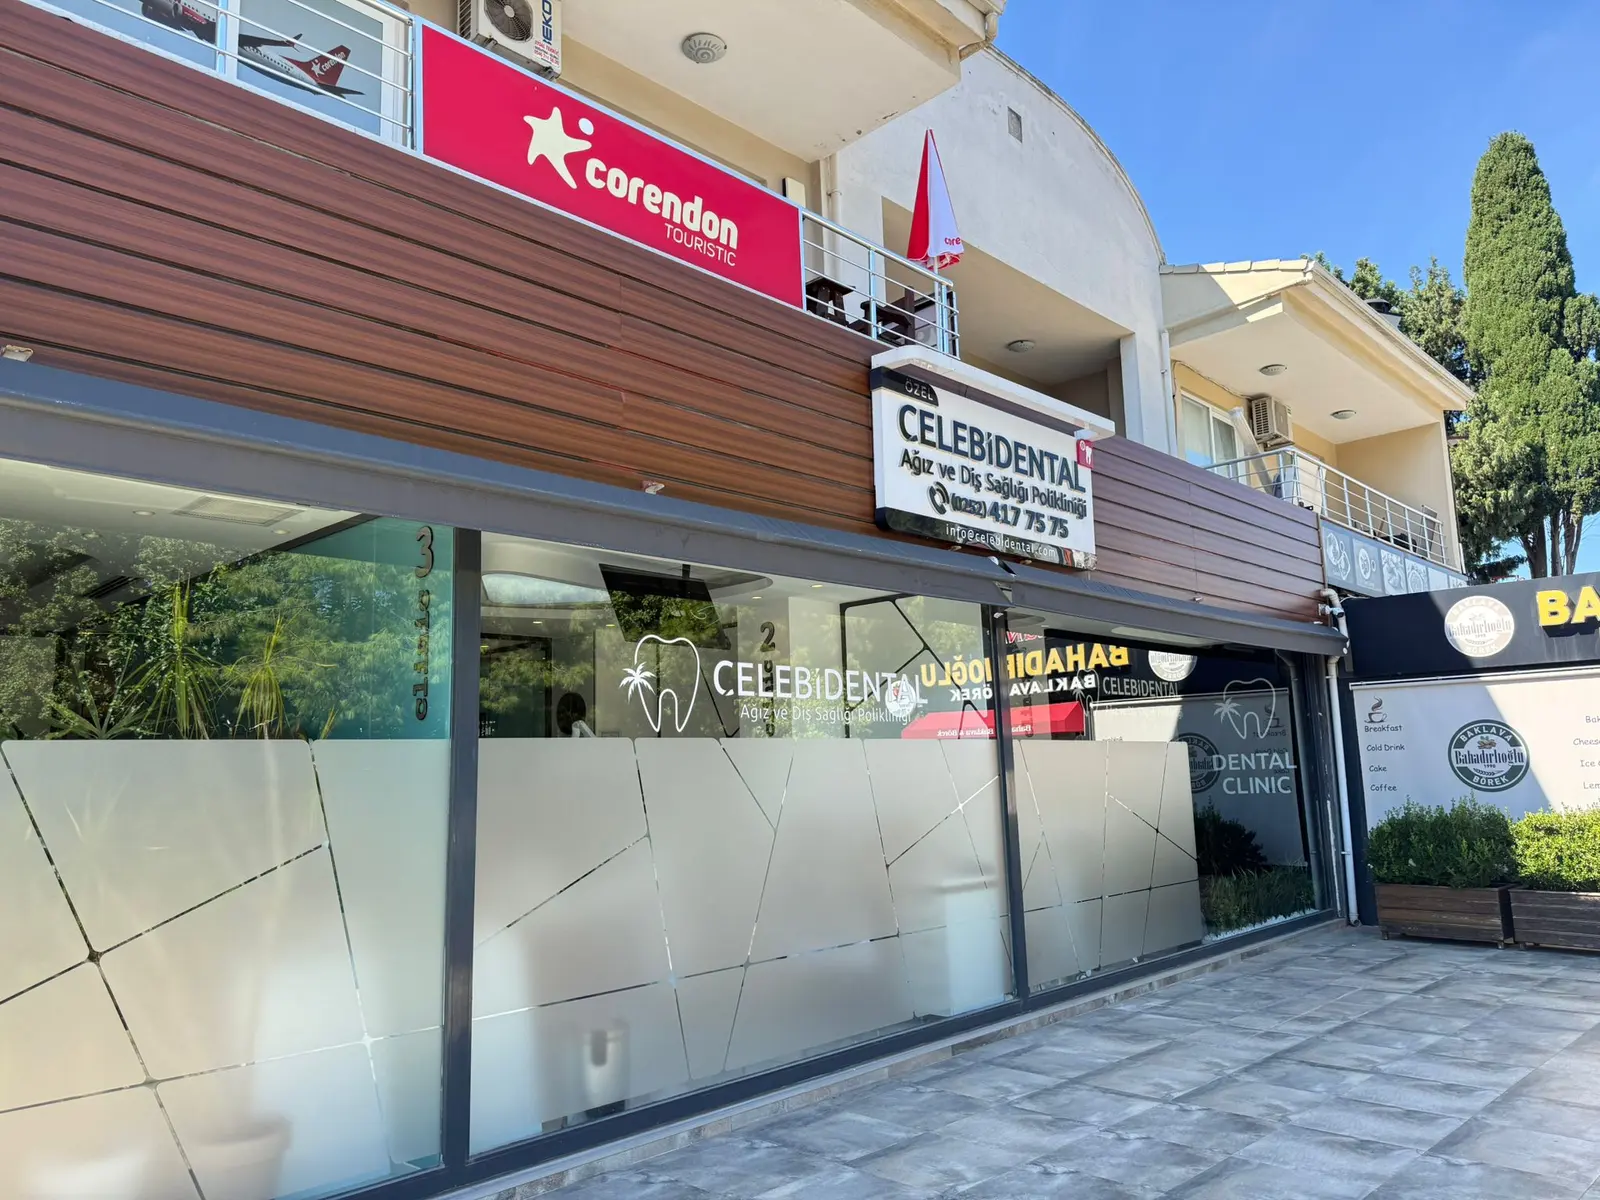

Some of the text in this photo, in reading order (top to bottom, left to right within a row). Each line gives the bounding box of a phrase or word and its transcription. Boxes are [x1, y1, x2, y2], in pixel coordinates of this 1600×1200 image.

[585, 157, 738, 250] corendon
[664, 222, 737, 267] TOURISTIC
[904, 377, 934, 401] ÖZEL
[899, 448, 1088, 520] Ağız ve Diş Sağlığı Polikliniği
[951, 492, 1070, 539] (0252) 417 75 75
[760, 621, 776, 651] 2
[740, 702, 770, 723] Ağız
[774, 708, 788, 721] ve
[792, 705, 812, 724] Diş
[1364, 725, 1403, 733] Breakfast
[1460, 725, 1513, 743] BAKLAVA
[1366, 744, 1405, 752] Cold Drink
[1212, 752, 1298, 771] DENTAL
[1368, 765, 1387, 773] Cake
[1580, 759, 1596, 768] Ice
[1222, 776, 1292, 795] CLINIC
[1370, 784, 1397, 792] Coffee
[1472, 775, 1510, 787] BÖREK
